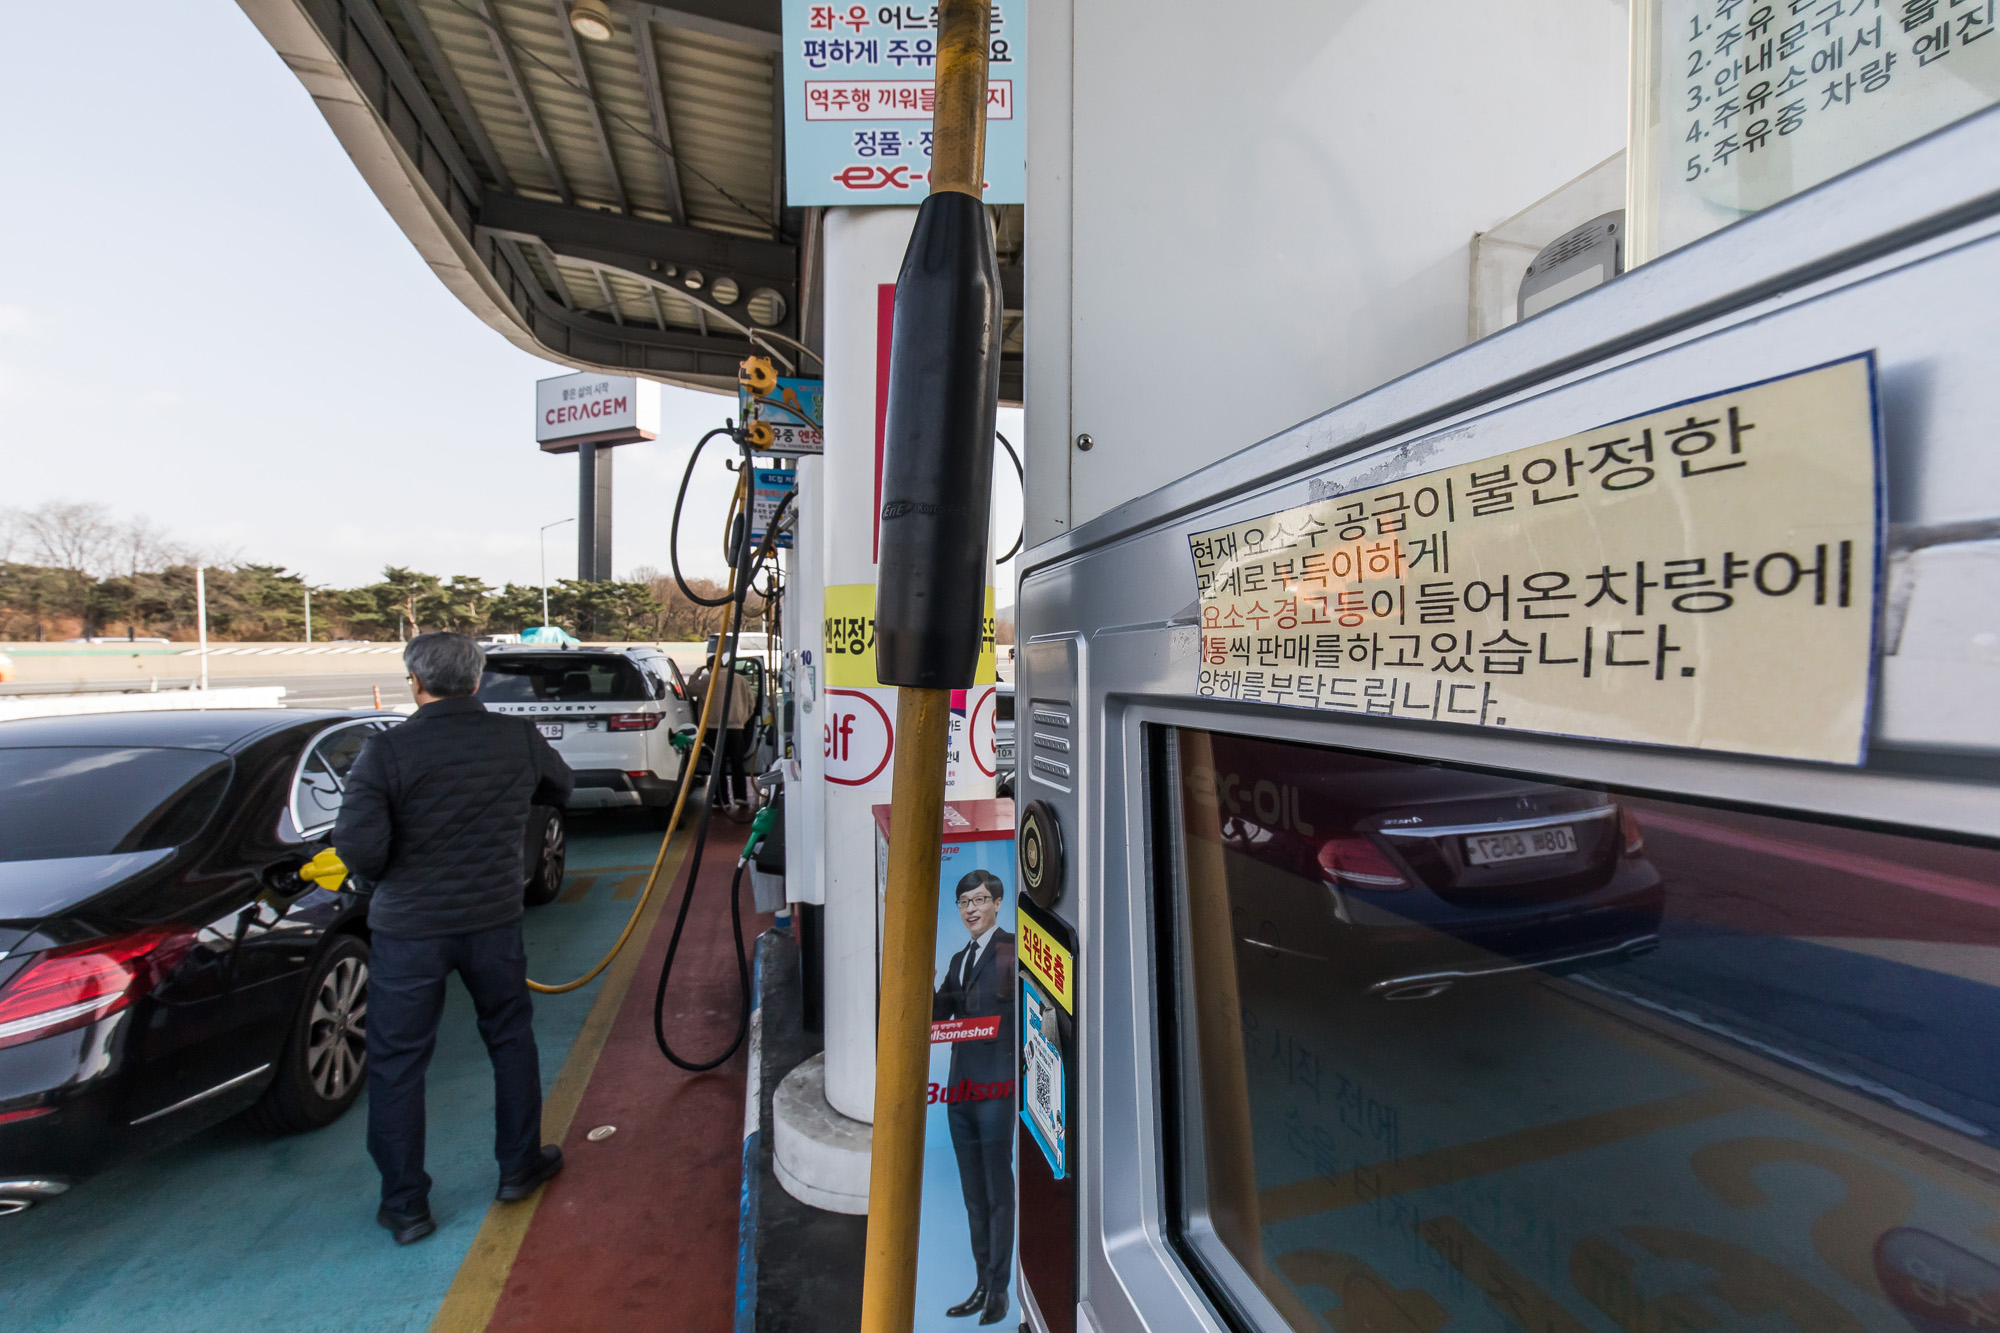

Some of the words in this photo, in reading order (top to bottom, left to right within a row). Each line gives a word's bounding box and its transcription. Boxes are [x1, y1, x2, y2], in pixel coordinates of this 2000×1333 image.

[803, 39, 878, 68] 편하게
[1820, 51, 1897, 111] 차량
[1912, 0, 1995, 67] 엔진
[810, 88, 871, 112] 역주행
[878, 88, 935, 112] 끼워들
[594, 382, 609, 395] 시작
[545, 396, 627, 425] CERAGEM
[1193, 532, 1239, 570] 현재
[1243, 514, 1329, 556] 요소수
[1334, 478, 1455, 542] 공급이
[1465, 406, 1756, 518] 불안정한
[800, 650, 812, 666] 10
[1023, 924, 1065, 995] 직원호출
